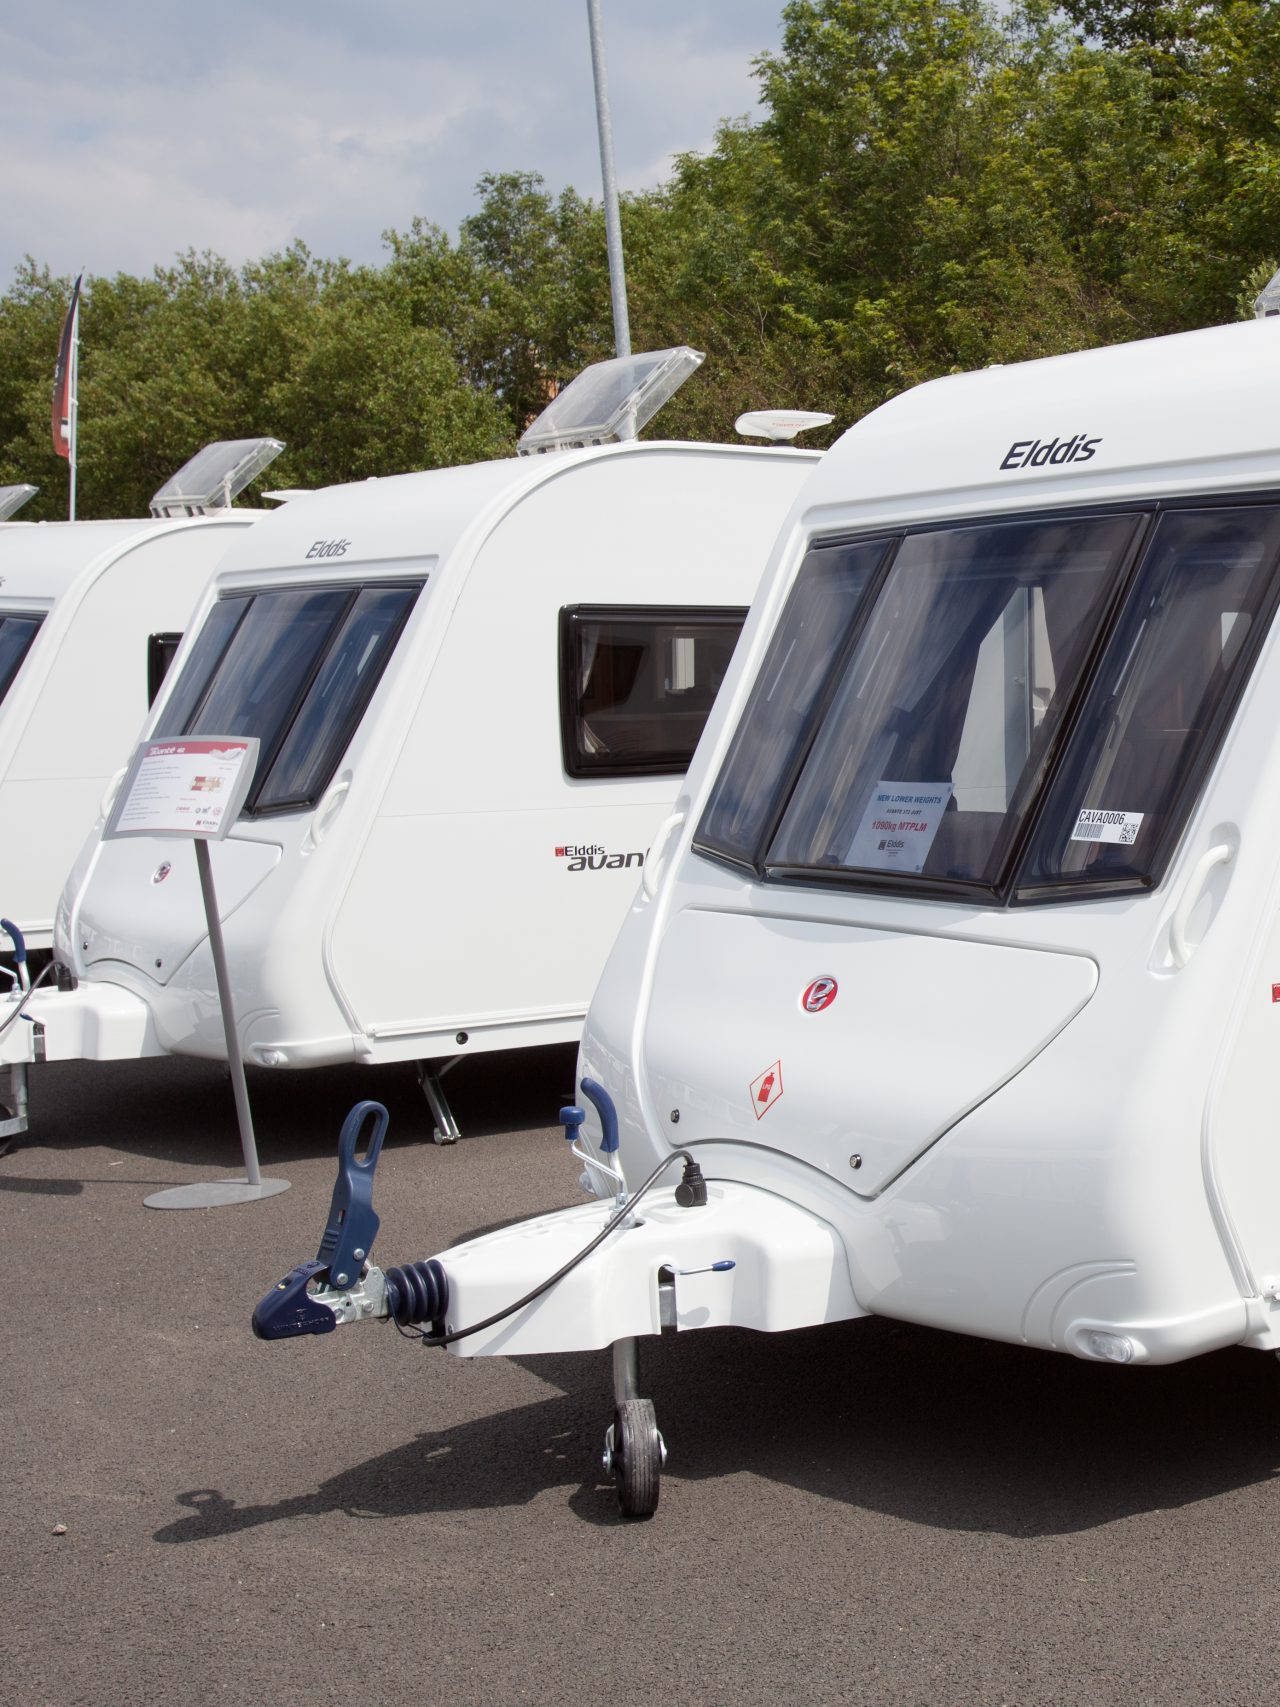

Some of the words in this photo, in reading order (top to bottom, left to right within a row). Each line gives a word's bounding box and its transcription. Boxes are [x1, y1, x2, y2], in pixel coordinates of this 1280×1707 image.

[999, 433, 1104, 471] Elddis
[305, 538, 352, 559] Elddis
[891, 795, 914, 803] LOWER
[914, 796, 942, 804] WEIGHTS
[1079, 811, 1126, 825] CAVA0006
[897, 821, 928, 832] MTPLM
[564, 845, 605, 856] Elddis
[886, 840, 905, 849] Elddis
[567, 847, 650, 872] avan
